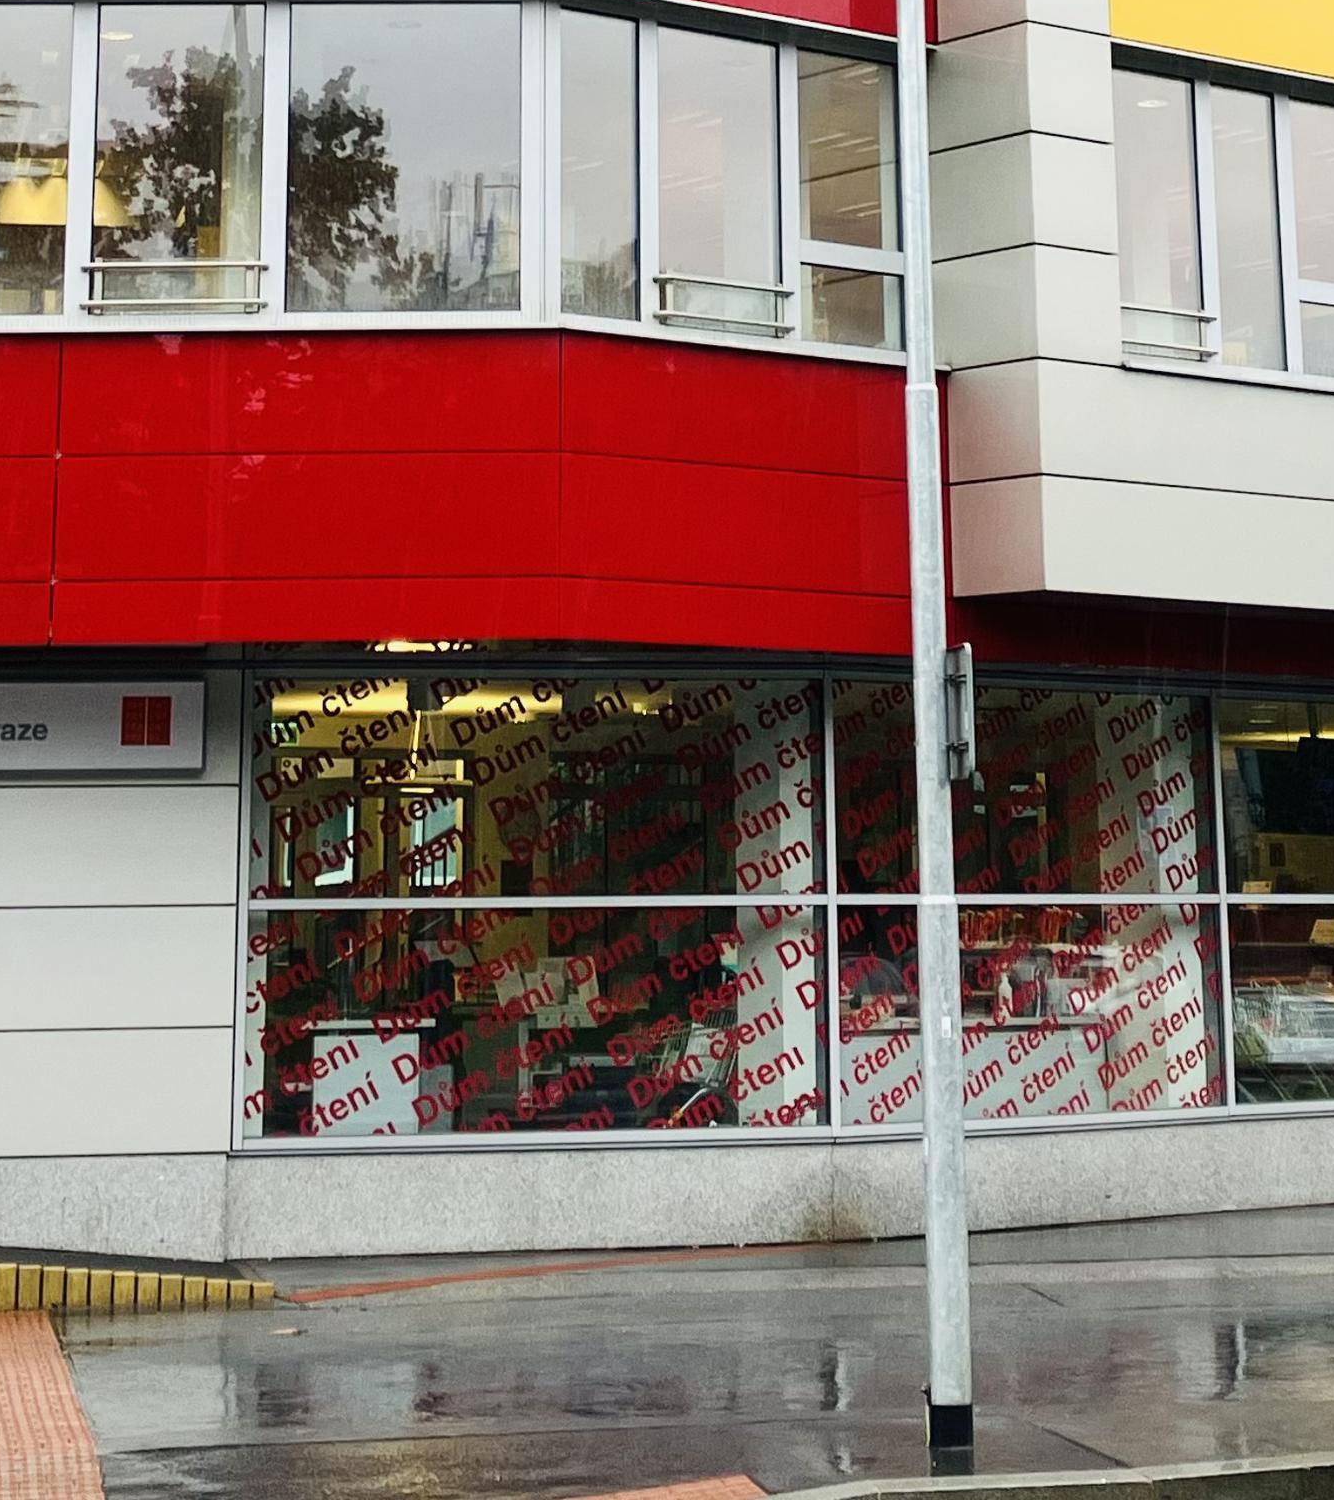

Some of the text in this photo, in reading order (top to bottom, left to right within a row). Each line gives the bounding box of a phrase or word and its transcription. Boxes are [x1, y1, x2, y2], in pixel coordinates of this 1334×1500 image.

[660, 683, 732, 734] Dům
[1106, 699, 1158, 744] Dům
[255, 750, 335, 802] Dům
[276, 789, 356, 843] Dům
[450, 696, 526, 748] Dům
[296, 829, 374, 881] Dům
[470, 735, 546, 787] Dům
[552, 682, 627, 742] čtení
[1122, 734, 1172, 781] Dům
[1136, 772, 1188, 818] Dům
[717, 800, 791, 853] Dům
[1152, 809, 1203, 854] Dům
[736, 840, 811, 893] Dům
[708, 997, 785, 1061] čtení
[1082, 1004, 1135, 1055] Dům
[1135, 951, 1188, 1010] čtení
[852, 1020, 913, 1085] čtení
[1020, 1042, 1077, 1105] čtení
[1097, 1041, 1151, 1093] Dům
[1149, 988, 1203, 1048] čtení
[1164, 1028, 1218, 1084] čtení
[411, 1069, 492, 1127] Dům
